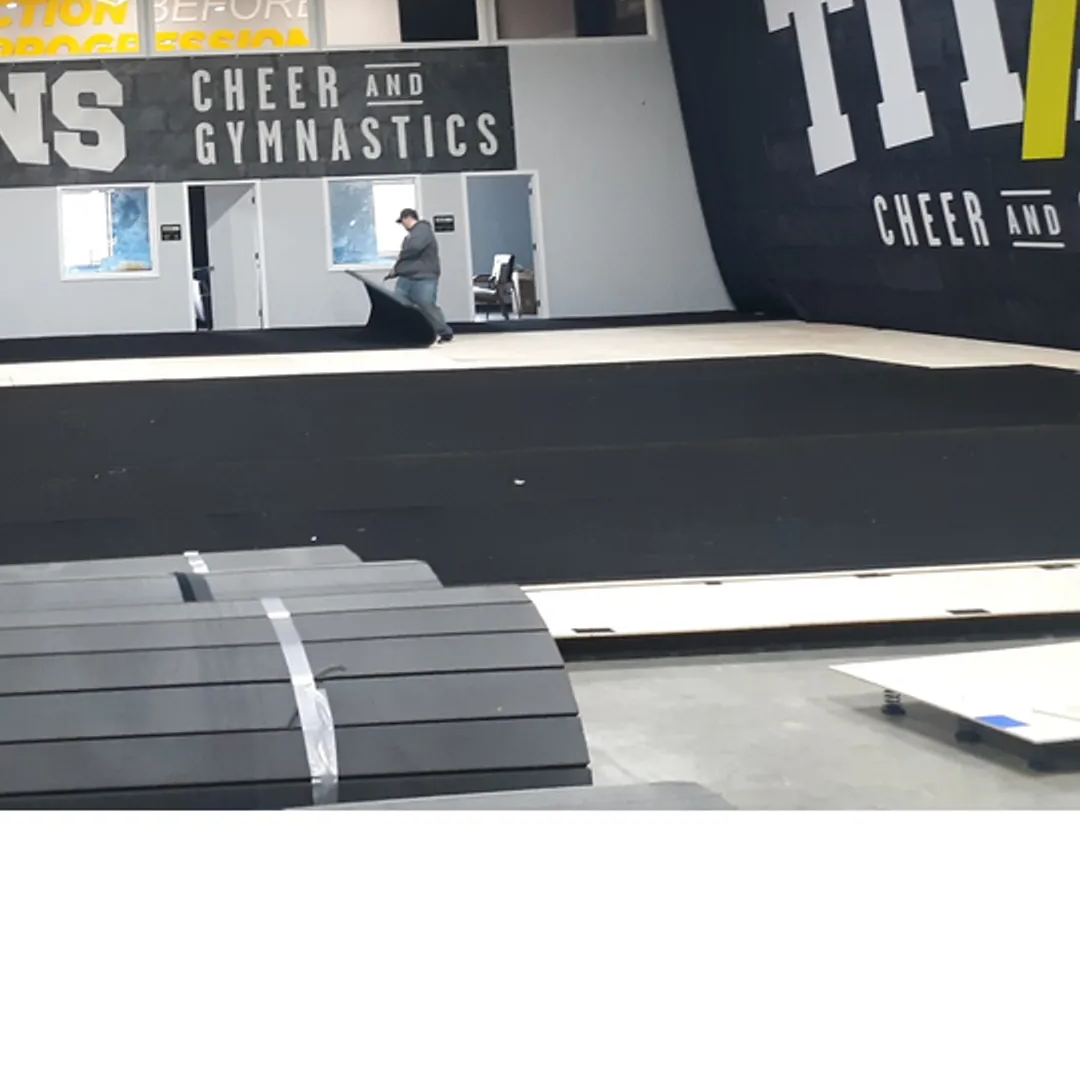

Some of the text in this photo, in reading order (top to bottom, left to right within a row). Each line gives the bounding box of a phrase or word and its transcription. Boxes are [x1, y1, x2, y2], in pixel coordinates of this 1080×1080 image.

[192, 66, 423, 113] CHEER AND
[195, 113, 500, 166] GYMNASTICS
[873, 190, 1061, 247] CHEER AND
